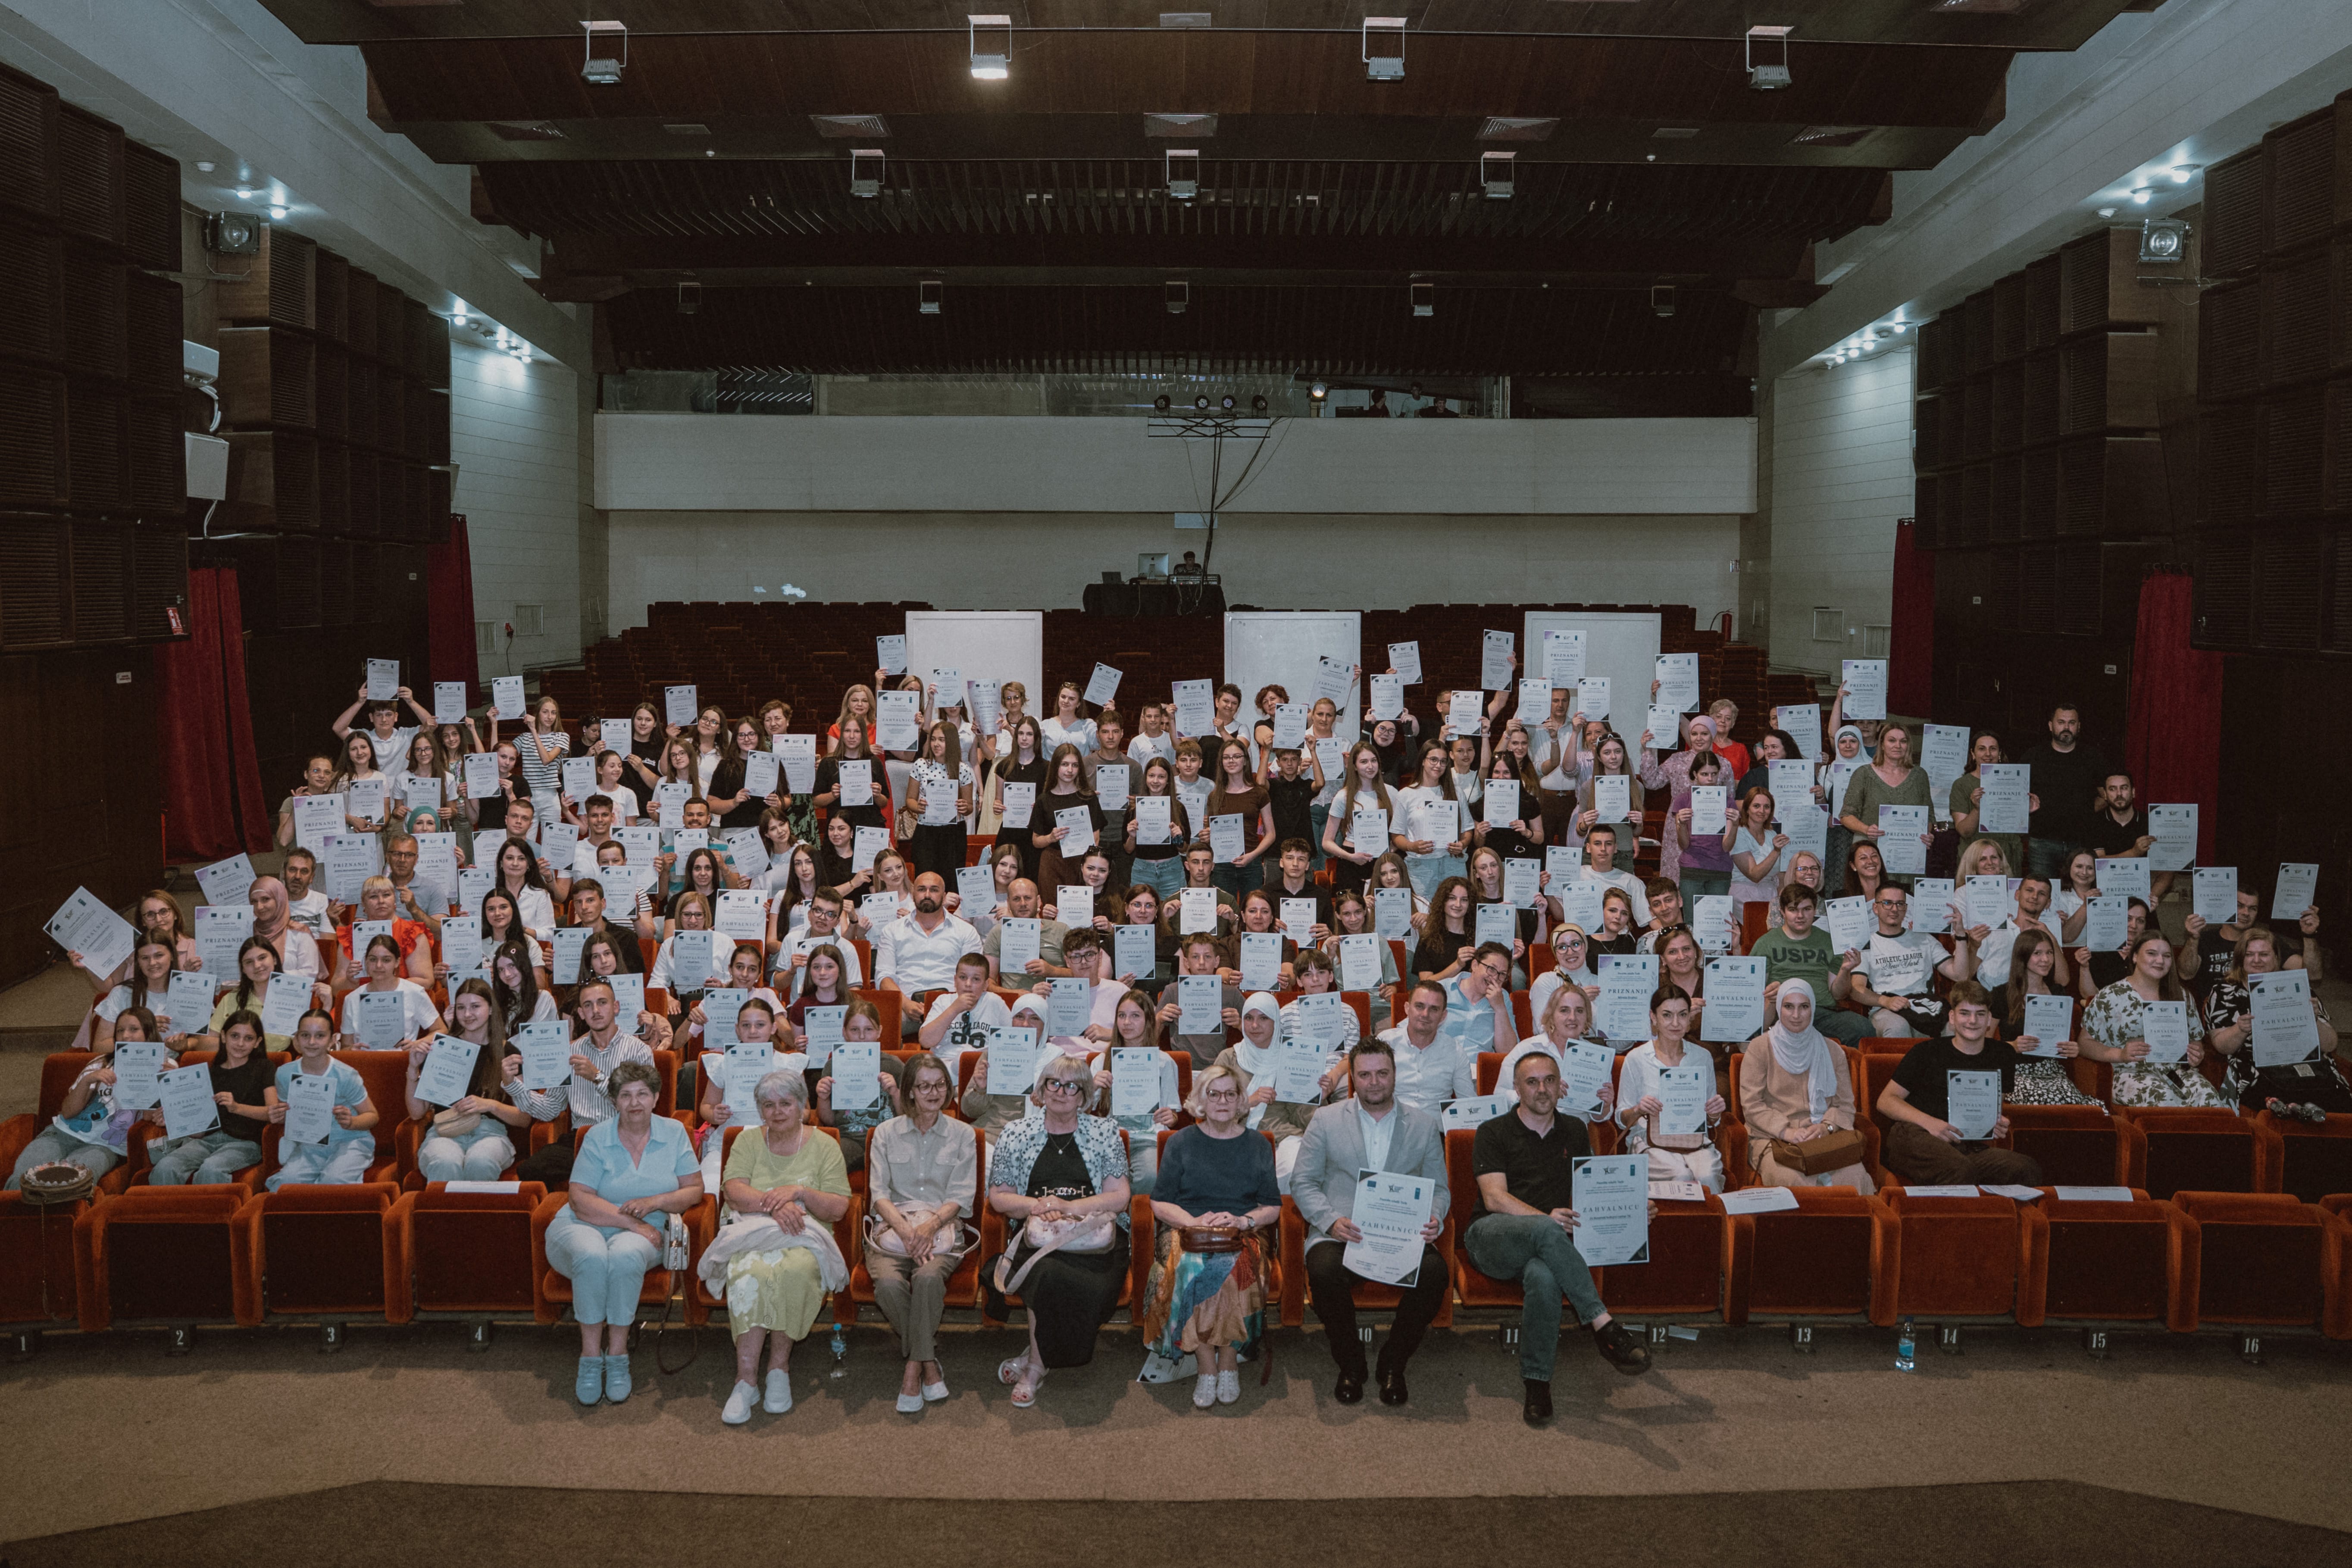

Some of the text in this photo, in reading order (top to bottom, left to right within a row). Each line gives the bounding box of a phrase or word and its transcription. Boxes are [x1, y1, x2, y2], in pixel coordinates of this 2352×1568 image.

[1318, 680, 1346, 689] ZAHVALNICU
[215, 882, 249, 898] PRIZNANJE
[1772, 947, 1829, 964] USPA
[1875, 955, 1902, 965] ATHLETIC
[2209, 952, 2228, 962] TOM
[2261, 1017, 2308, 1025] ZAHVALNICU
[1567, 1072, 1603, 1082] ZAHVALNICU
[1362, 1221, 1419, 1235] ZAHVALNICU
[176, 1330, 184, 1345] 2
[327, 1327, 335, 1342] 3
[475, 1326, 482, 1341] 4
[1358, 1328, 1372, 1342] 10
[1506, 1328, 1518, 1343] 11
[1652, 1327, 1665, 1343] 12
[1798, 1327, 1811, 1342] 13
[1944, 1328, 1957, 1343] 14
[2092, 1333, 2105, 1348] 15
[20, 1336, 26, 1351] 1
[2245, 1338, 2258, 1353] 16
